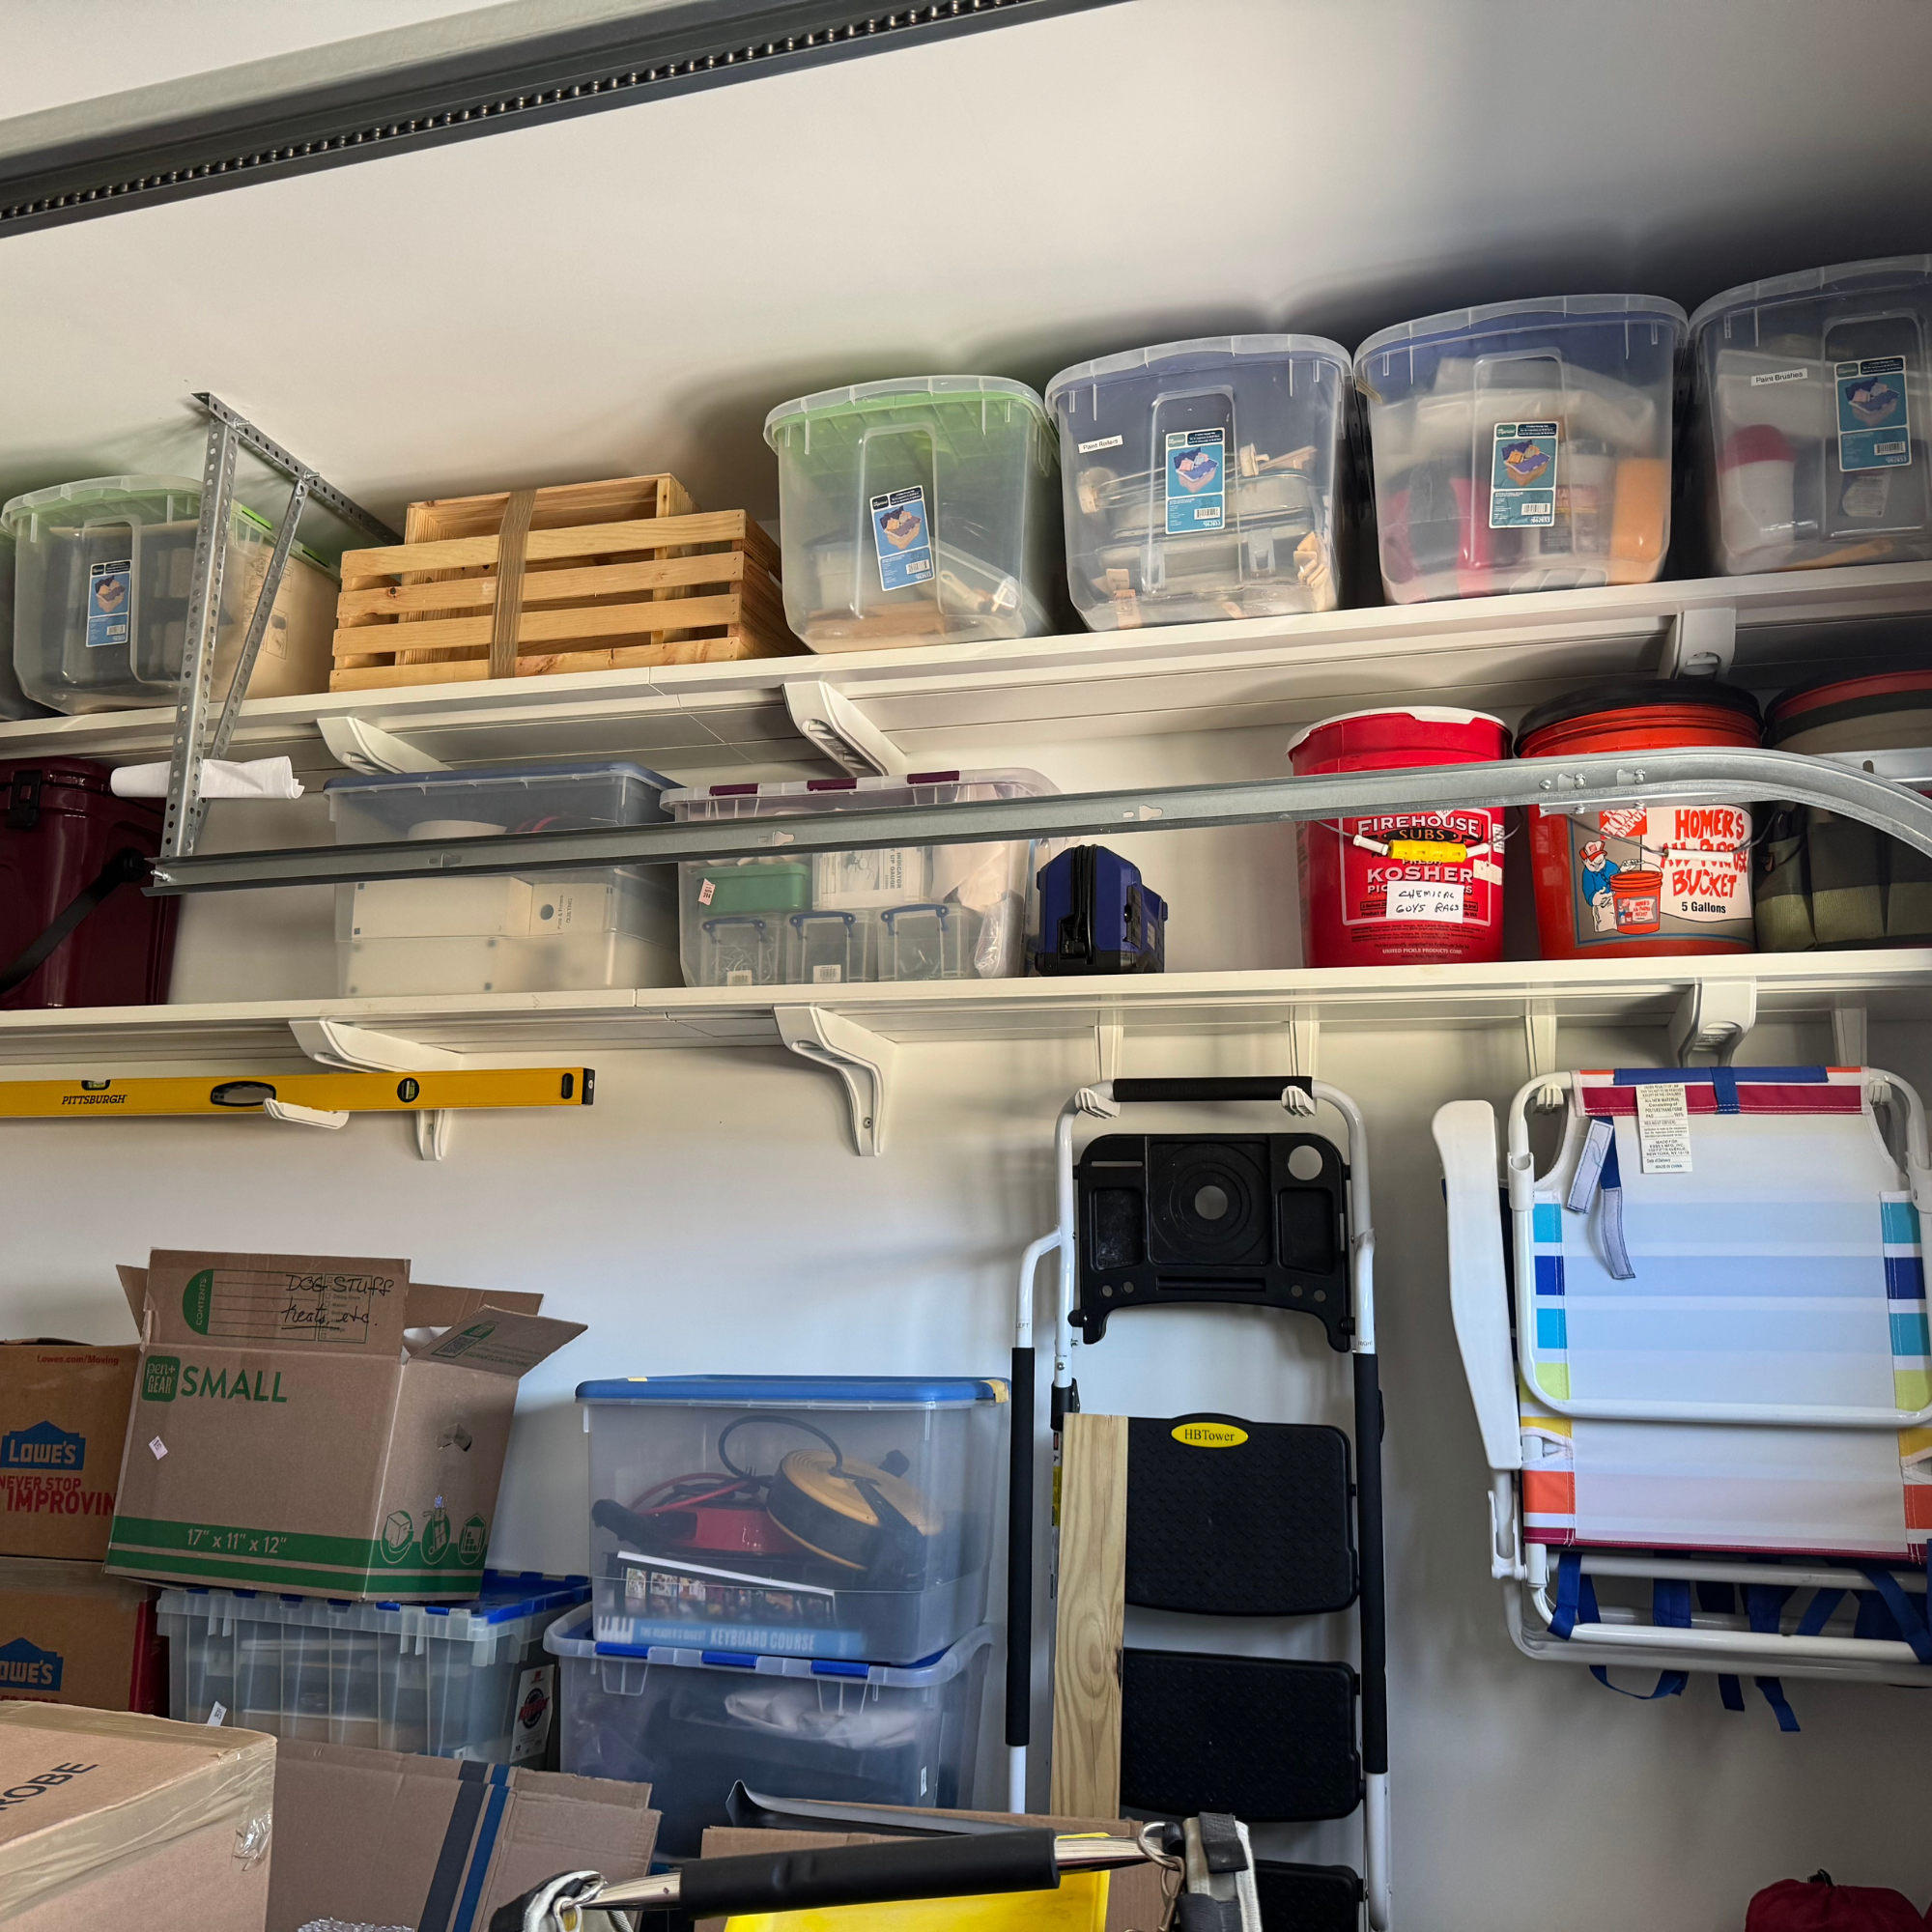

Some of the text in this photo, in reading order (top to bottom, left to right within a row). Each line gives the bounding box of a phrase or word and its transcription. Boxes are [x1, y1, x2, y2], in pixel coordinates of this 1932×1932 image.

[1756, 371, 1804, 384] Paint Brushes
[1099, 438, 1119, 448] Rollers
[1357, 815, 1480, 838] FIREHOUSE
[1675, 809, 1745, 840] HOMER'S
[1399, 829, 1445, 840] SUBS
[890, 854, 895, 864] UP
[1367, 866, 1474, 884] KOSHER
[1672, 869, 1738, 898] BUCKET
[1398, 889, 1455, 899] CHEMICAL
[1395, 902, 1426, 913] GUYS
[1434, 902, 1460, 913] RAGS
[1681, 901, 1726, 914] 5 Gallons
[61, 1094, 126, 1105] PITTSBURGH
[286, 1274, 327, 1292] DOG
[196, 1278, 207, 1326] CONTENTS
[37, 1354, 119, 1366] Lowes.com/Moving
[147, 1376, 172, 1394] GEAR
[180, 1365, 288, 1403] SMALL
[1184, 1428, 1235, 1442] HBTower
[8, 1439, 77, 1465] LOWE'S
[0, 1475, 82, 1492] NEVER STOP
[6, 1487, 116, 1516] IMPROVIN
[187, 1528, 287, 1554] 17" x 11" x 12"
[710, 1628, 767, 1649] KEYBOARD
[770, 1631, 815, 1652] COURSE
[0, 1659, 54, 1685] OWE'S
